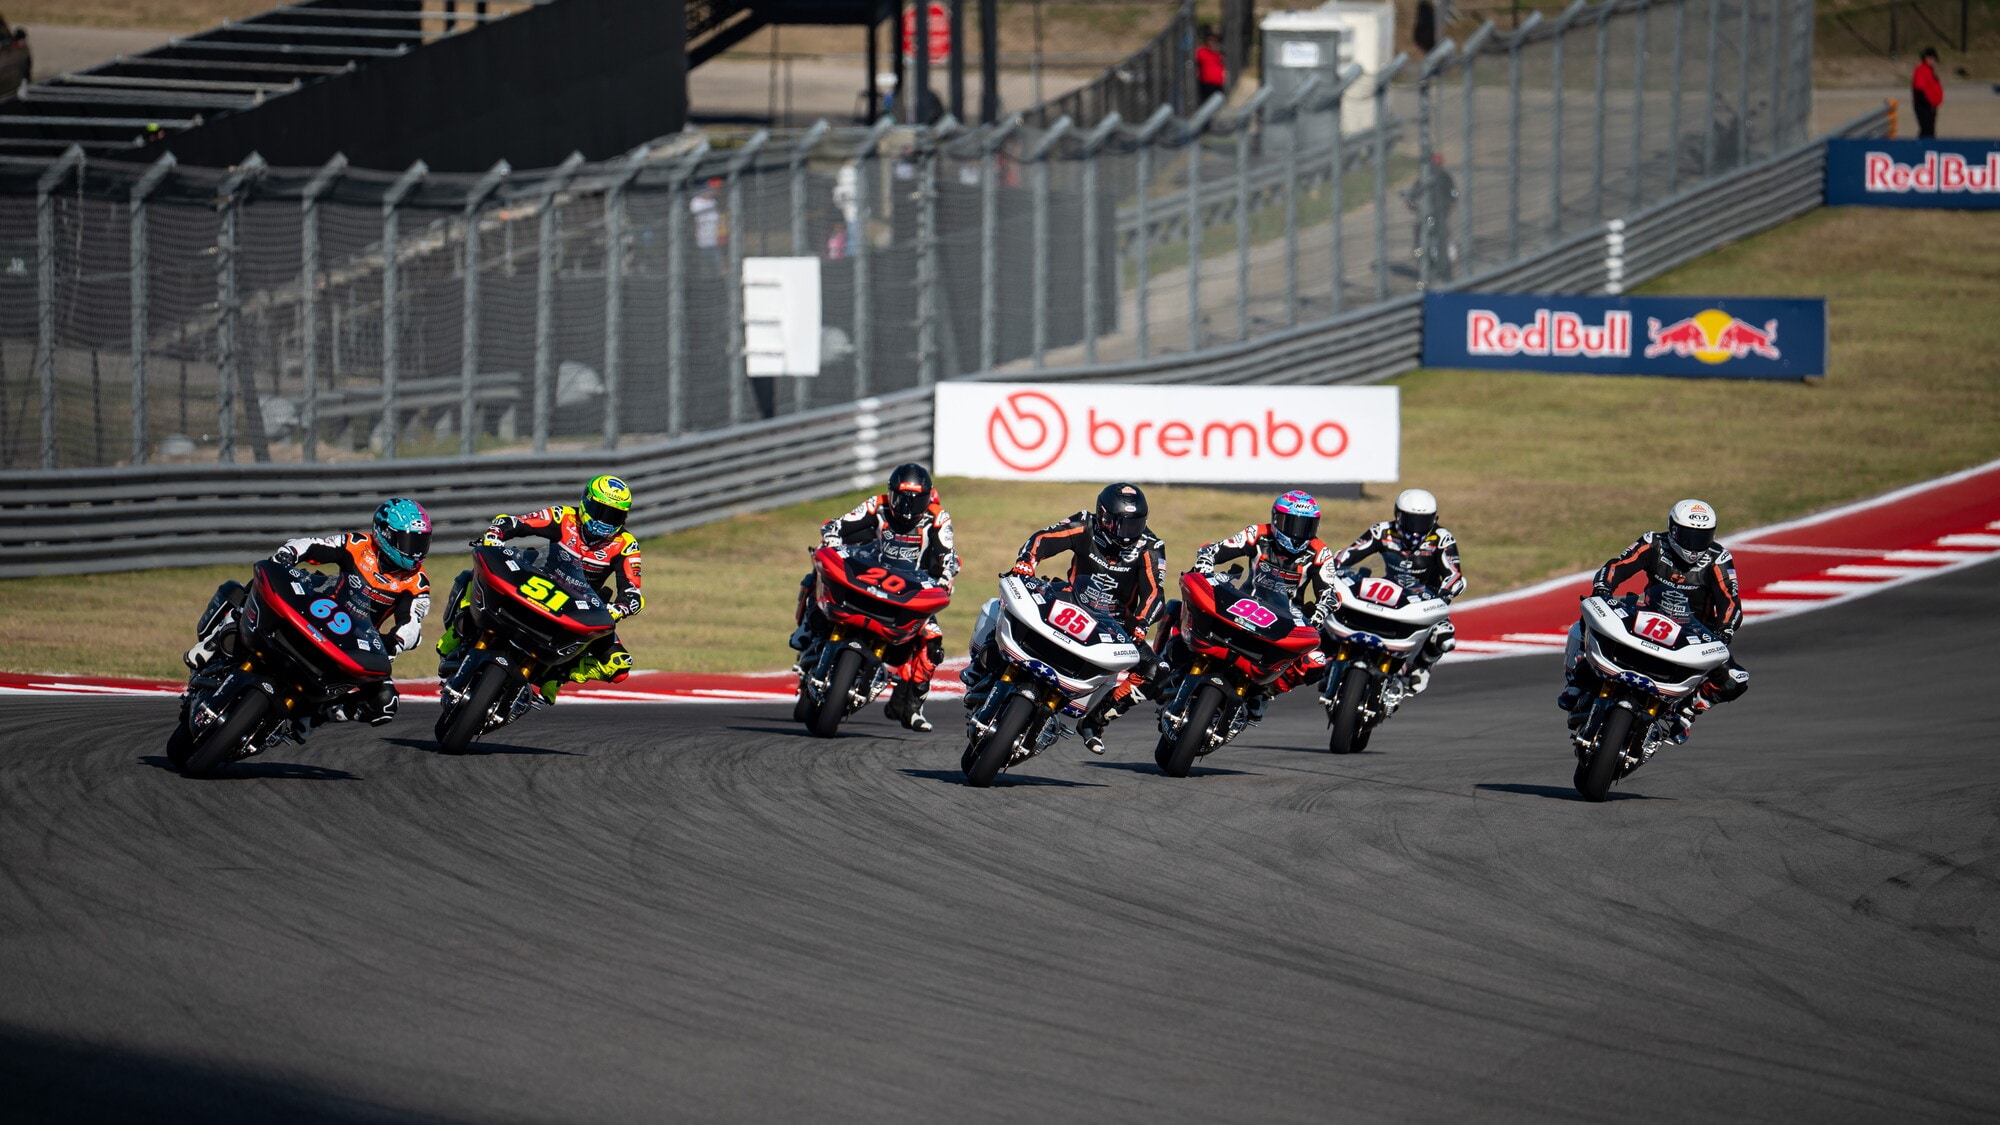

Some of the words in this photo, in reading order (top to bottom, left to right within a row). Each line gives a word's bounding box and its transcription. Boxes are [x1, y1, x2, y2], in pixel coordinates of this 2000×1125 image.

[1866, 151, 1938, 193] Red
[1940, 152, 2000, 193] Bul
[1467, 309, 1550, 356] Red
[1551, 310, 1632, 357] Bull
[1088, 409, 1349, 457] brembo
[1089, 553, 1131, 572] SADDLEMEN
[520, 575, 570, 612] 51
[855, 567, 907, 593] 20
[1366, 582, 1395, 602] 10
[1654, 574, 1699, 591] SADDLEMEN
[309, 598, 352, 635] 69
[1054, 607, 1089, 635] 85
[1227, 599, 1278, 628] 99
[1642, 617, 1673, 641] 13
